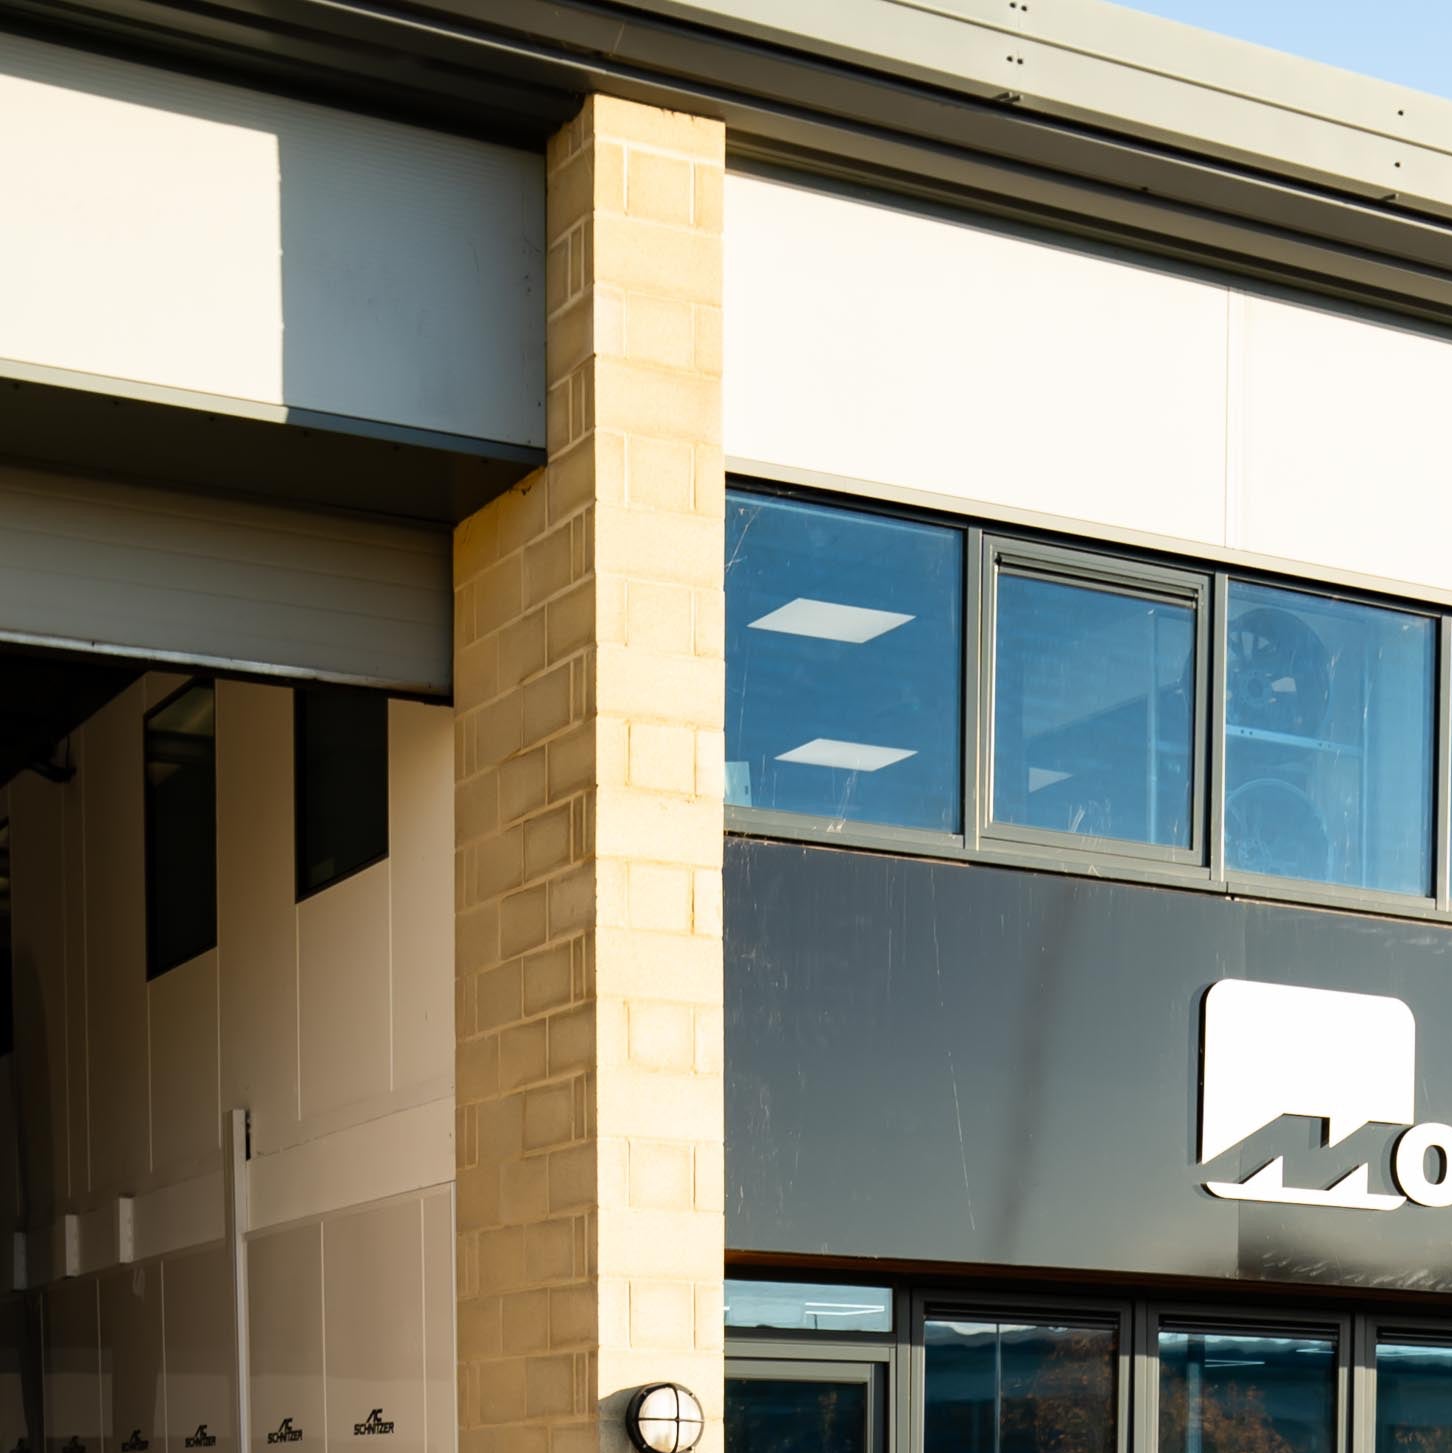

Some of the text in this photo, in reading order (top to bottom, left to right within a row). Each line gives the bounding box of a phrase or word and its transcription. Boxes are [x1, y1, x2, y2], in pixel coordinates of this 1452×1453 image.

[366, 1408, 383, 1423] AC
[353, 1421, 395, 1436] SCHNITZER
[267, 1429, 303, 1444] SCHNITZER
